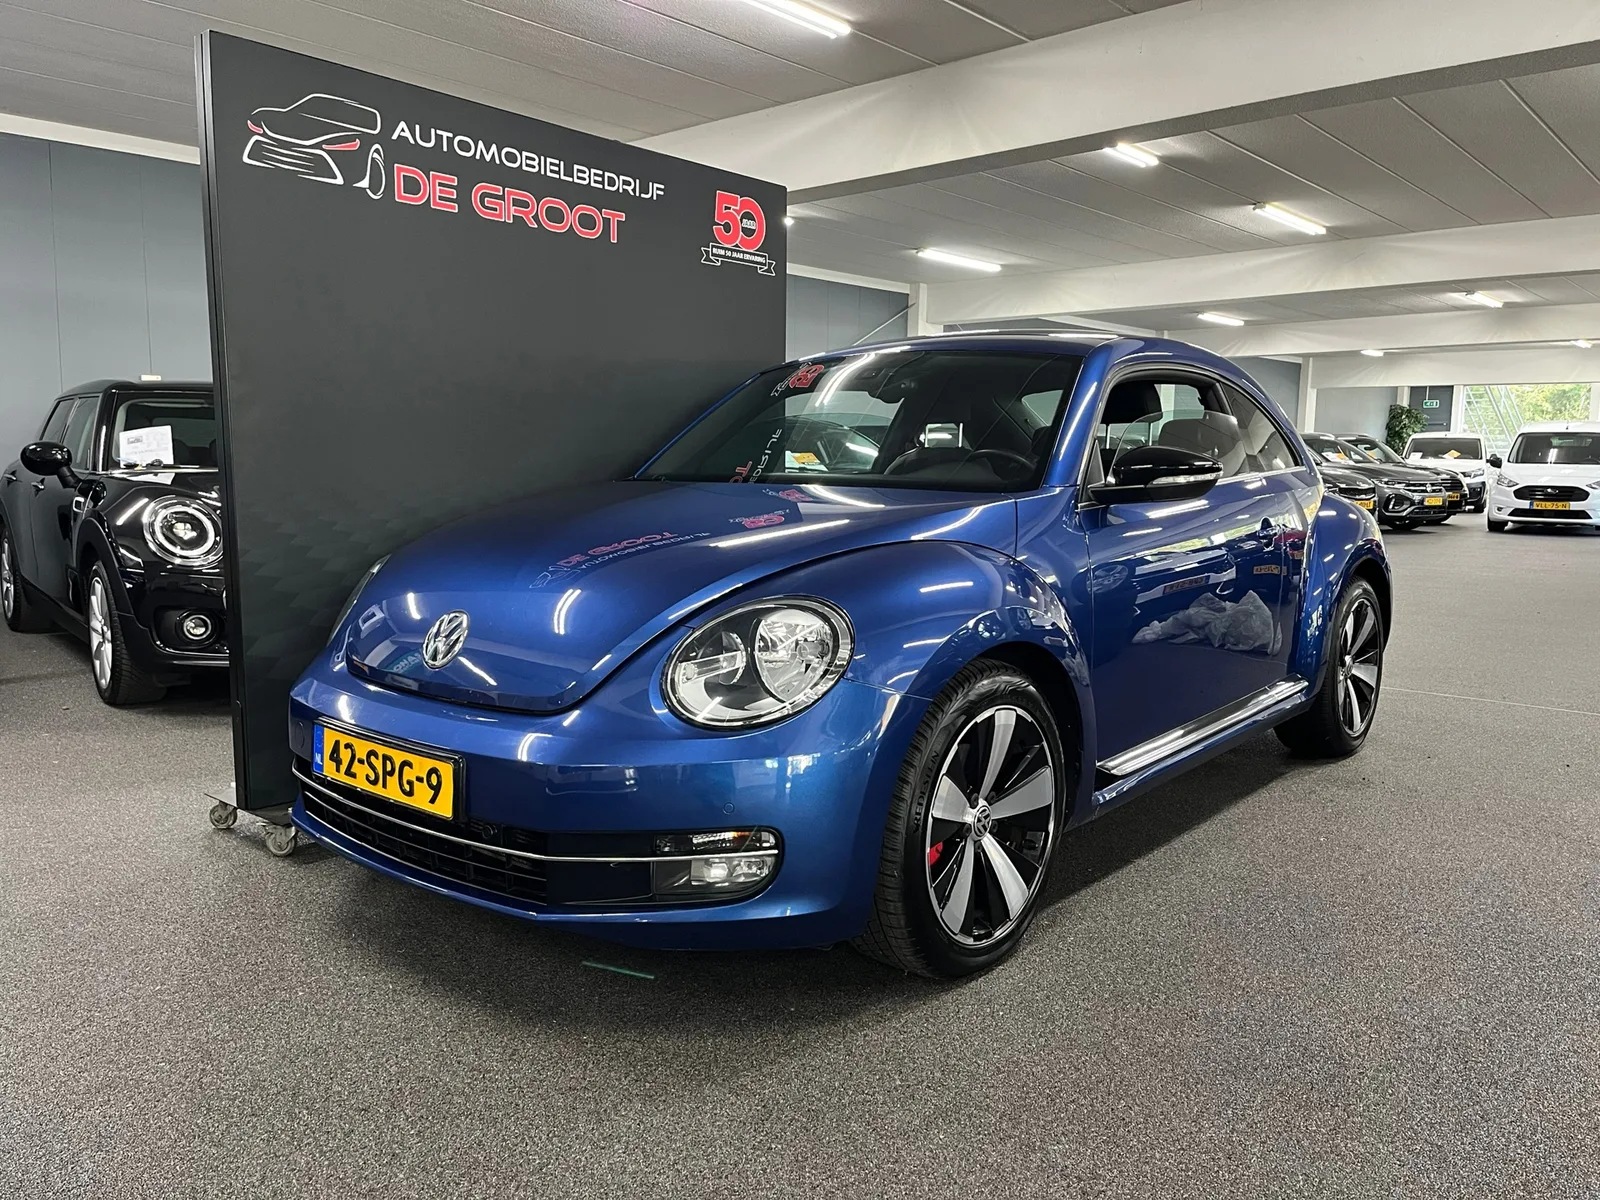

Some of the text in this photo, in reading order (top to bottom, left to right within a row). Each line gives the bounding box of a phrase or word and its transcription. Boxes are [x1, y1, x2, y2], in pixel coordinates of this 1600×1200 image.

[391, 120, 665, 200] AUTOMOBIELBEDRIJF
[394, 163, 625, 243] DE GROOT
[713, 190, 766, 251] 50
[712, 247, 726, 256] RUIM
[731, 251, 744, 260] JAAR
[743, 253, 766, 264] ERVARING
[329, 739, 443, 805] 42-SPG-9
